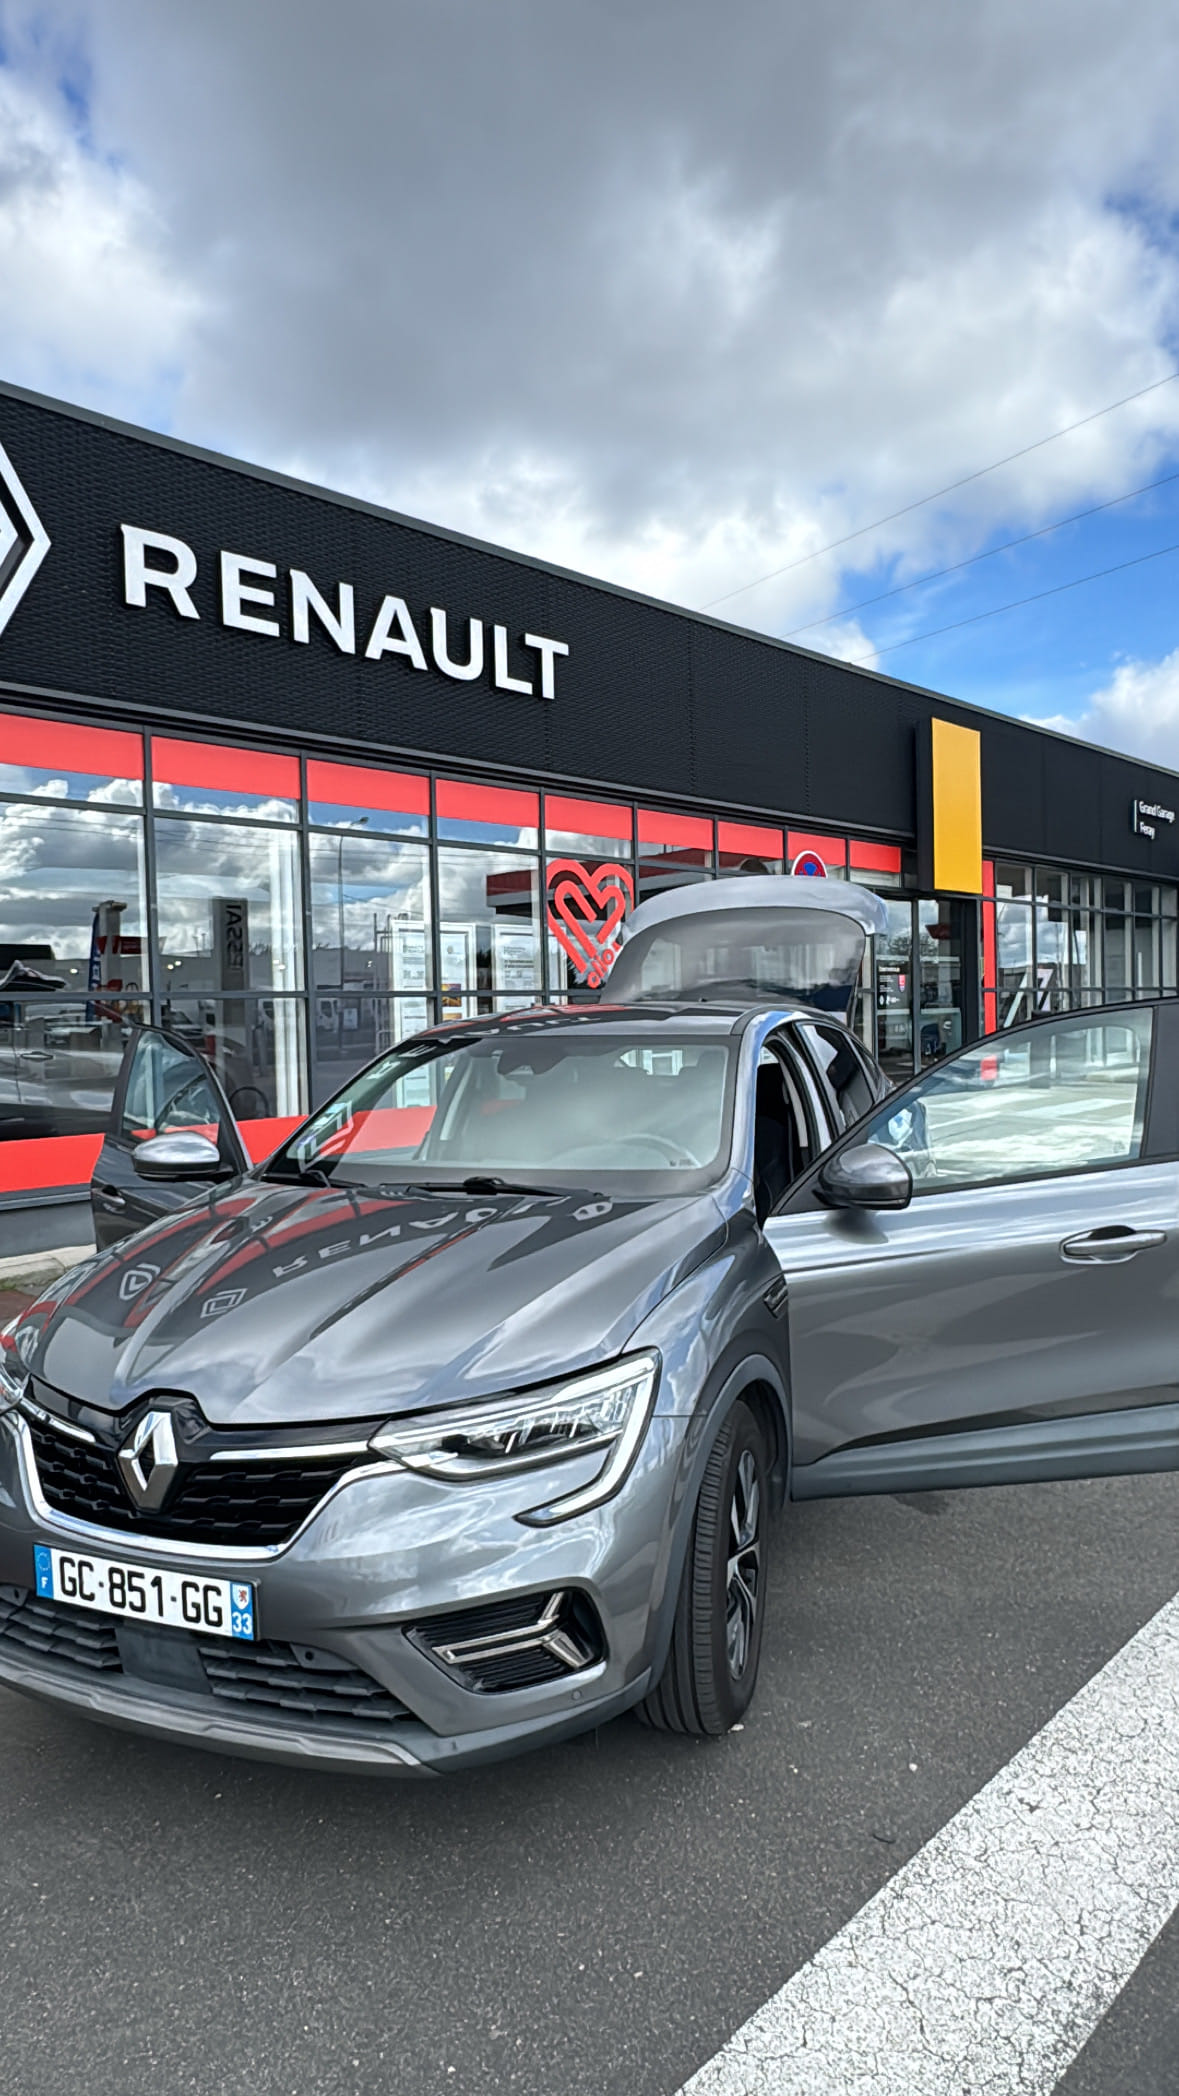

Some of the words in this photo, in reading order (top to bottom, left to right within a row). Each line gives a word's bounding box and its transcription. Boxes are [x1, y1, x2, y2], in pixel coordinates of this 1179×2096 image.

[121, 523, 570, 700] RENAULT
[1139, 801, 1157, 816] Grand
[40, 1576, 48, 1590] F
[59, 1556, 223, 1628] GC-851-GG
[231, 1611, 253, 1635] 33
